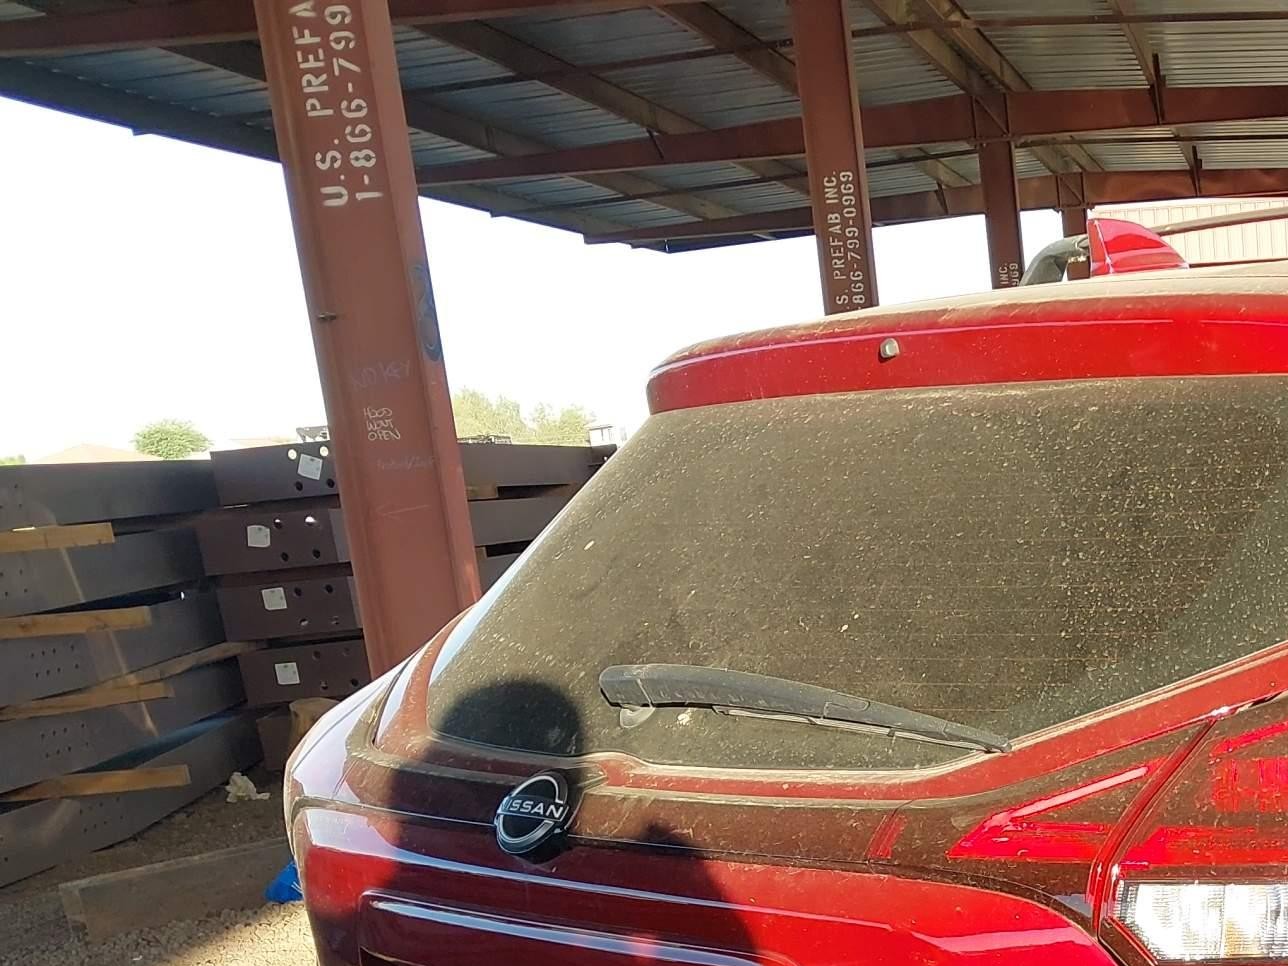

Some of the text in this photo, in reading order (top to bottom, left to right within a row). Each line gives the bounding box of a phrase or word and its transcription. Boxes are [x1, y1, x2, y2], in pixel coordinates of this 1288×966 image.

[288, 0, 349, 207] U.S. PREFA
[323, 5, 384, 201] 1-866-799
[823, 170, 840, 204] INC.
[827, 212, 847, 280] PREFAB
[367, 428, 401, 441] OPEN
[501, 798, 564, 819] NISSAN
